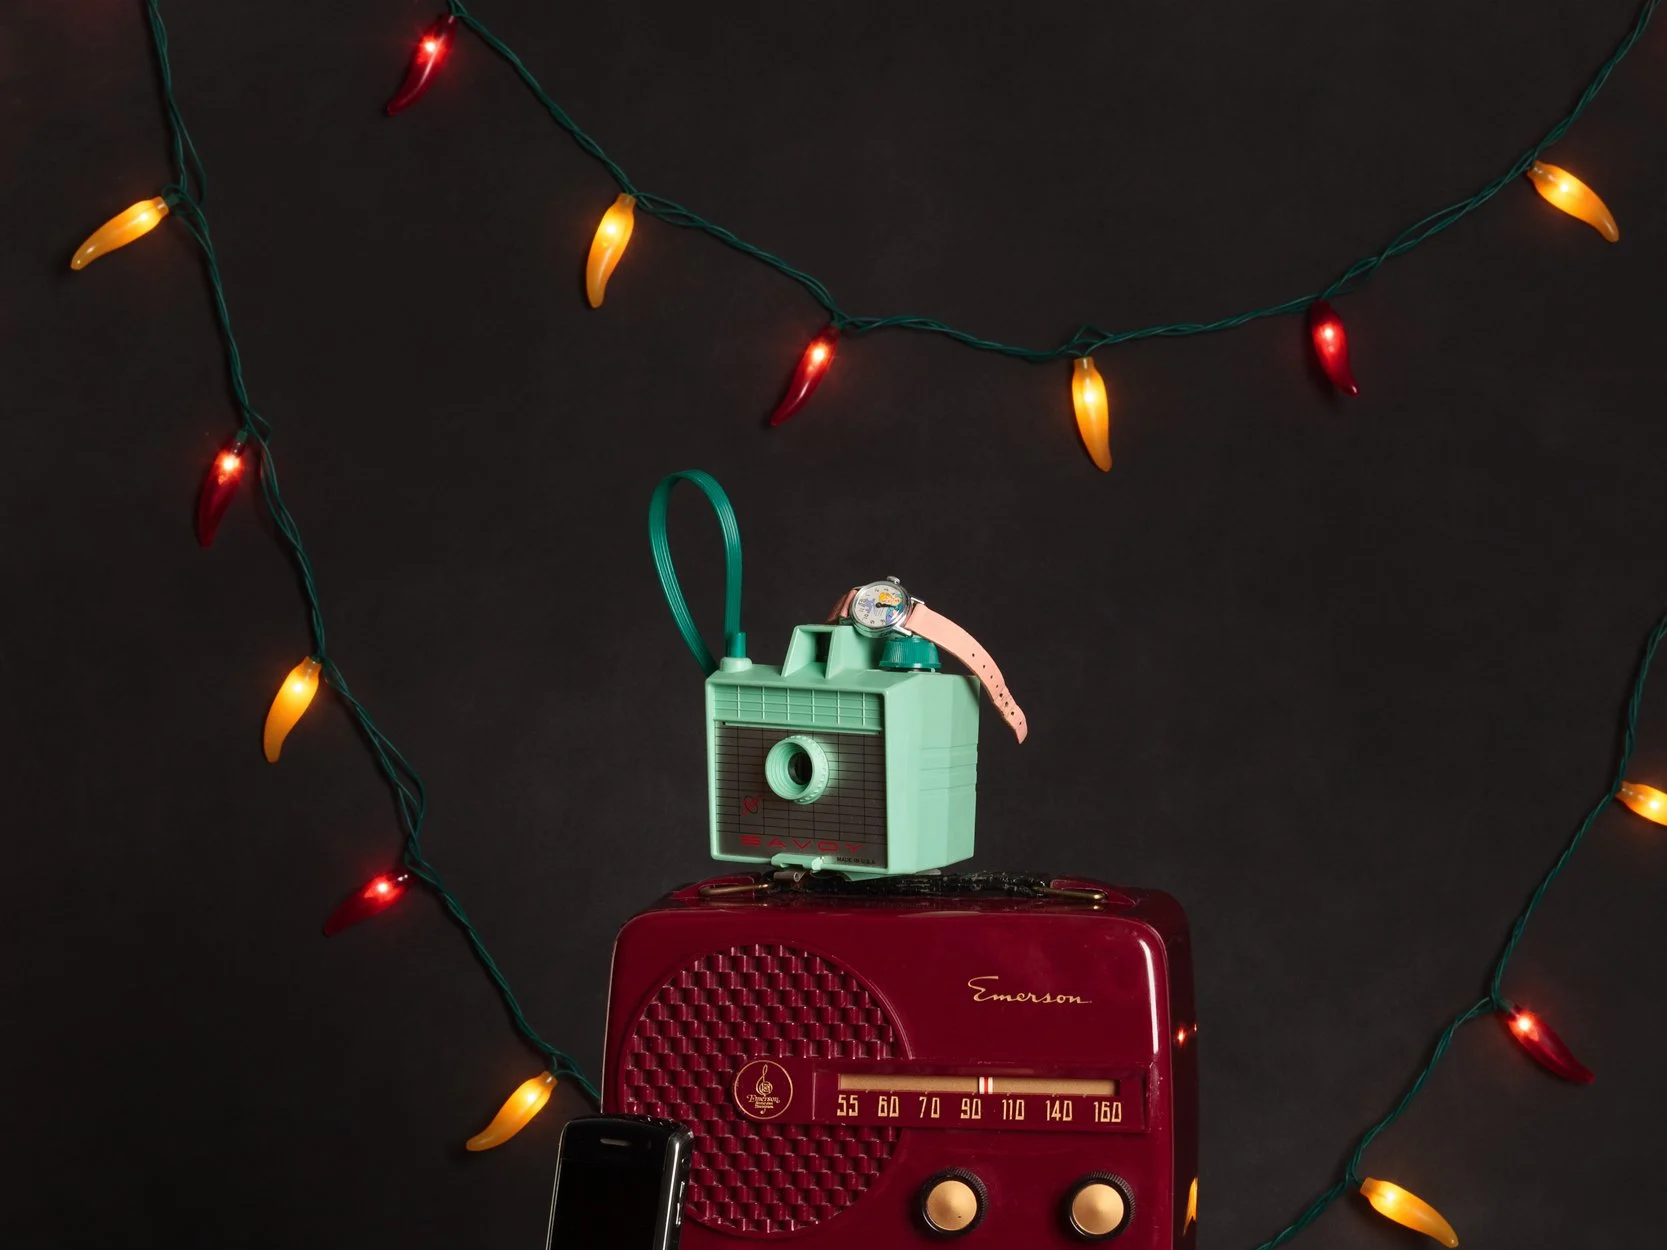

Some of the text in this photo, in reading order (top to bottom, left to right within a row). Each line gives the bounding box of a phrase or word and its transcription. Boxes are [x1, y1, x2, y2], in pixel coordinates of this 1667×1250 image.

[739, 835, 864, 853] SAVOY
[967, 976, 1091, 1004] Emerson
[837, 1094, 1122, 1123] 55 60 70 90 110 140 160
